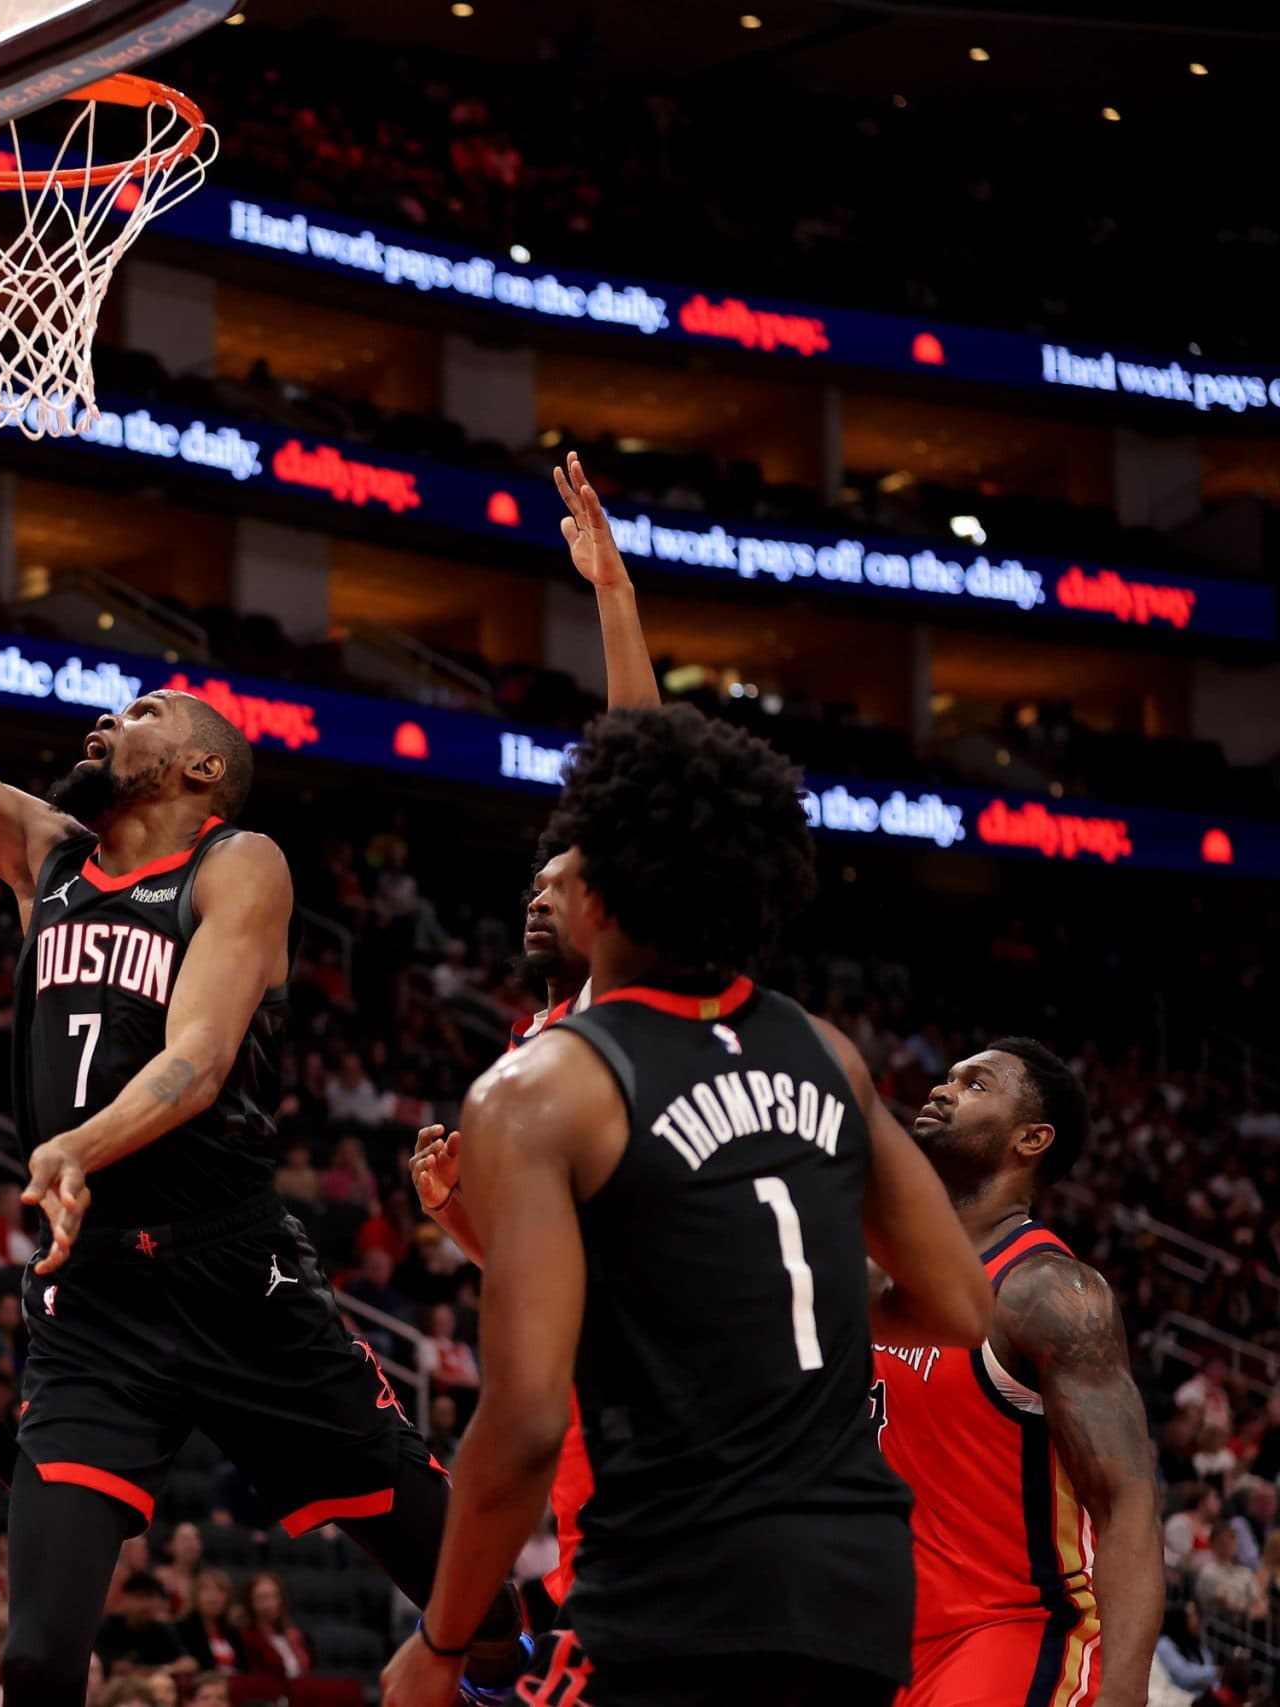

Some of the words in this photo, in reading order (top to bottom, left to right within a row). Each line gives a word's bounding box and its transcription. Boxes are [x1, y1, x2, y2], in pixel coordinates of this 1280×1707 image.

[231, 200, 308, 253] Hard
[1041, 344, 1118, 391] Hard
[1118, 361, 1193, 401] work
[1192, 373, 1268, 412] pays
[122, 409, 180, 458] the
[601, 506, 651, 557] ard
[651, 525, 738, 570] work
[36, 922, 176, 1007] OUSTON
[67, 1012, 103, 1109] 7
[651, 1070, 845, 1172] THOMPSON
[753, 1176, 824, 1371] 1
